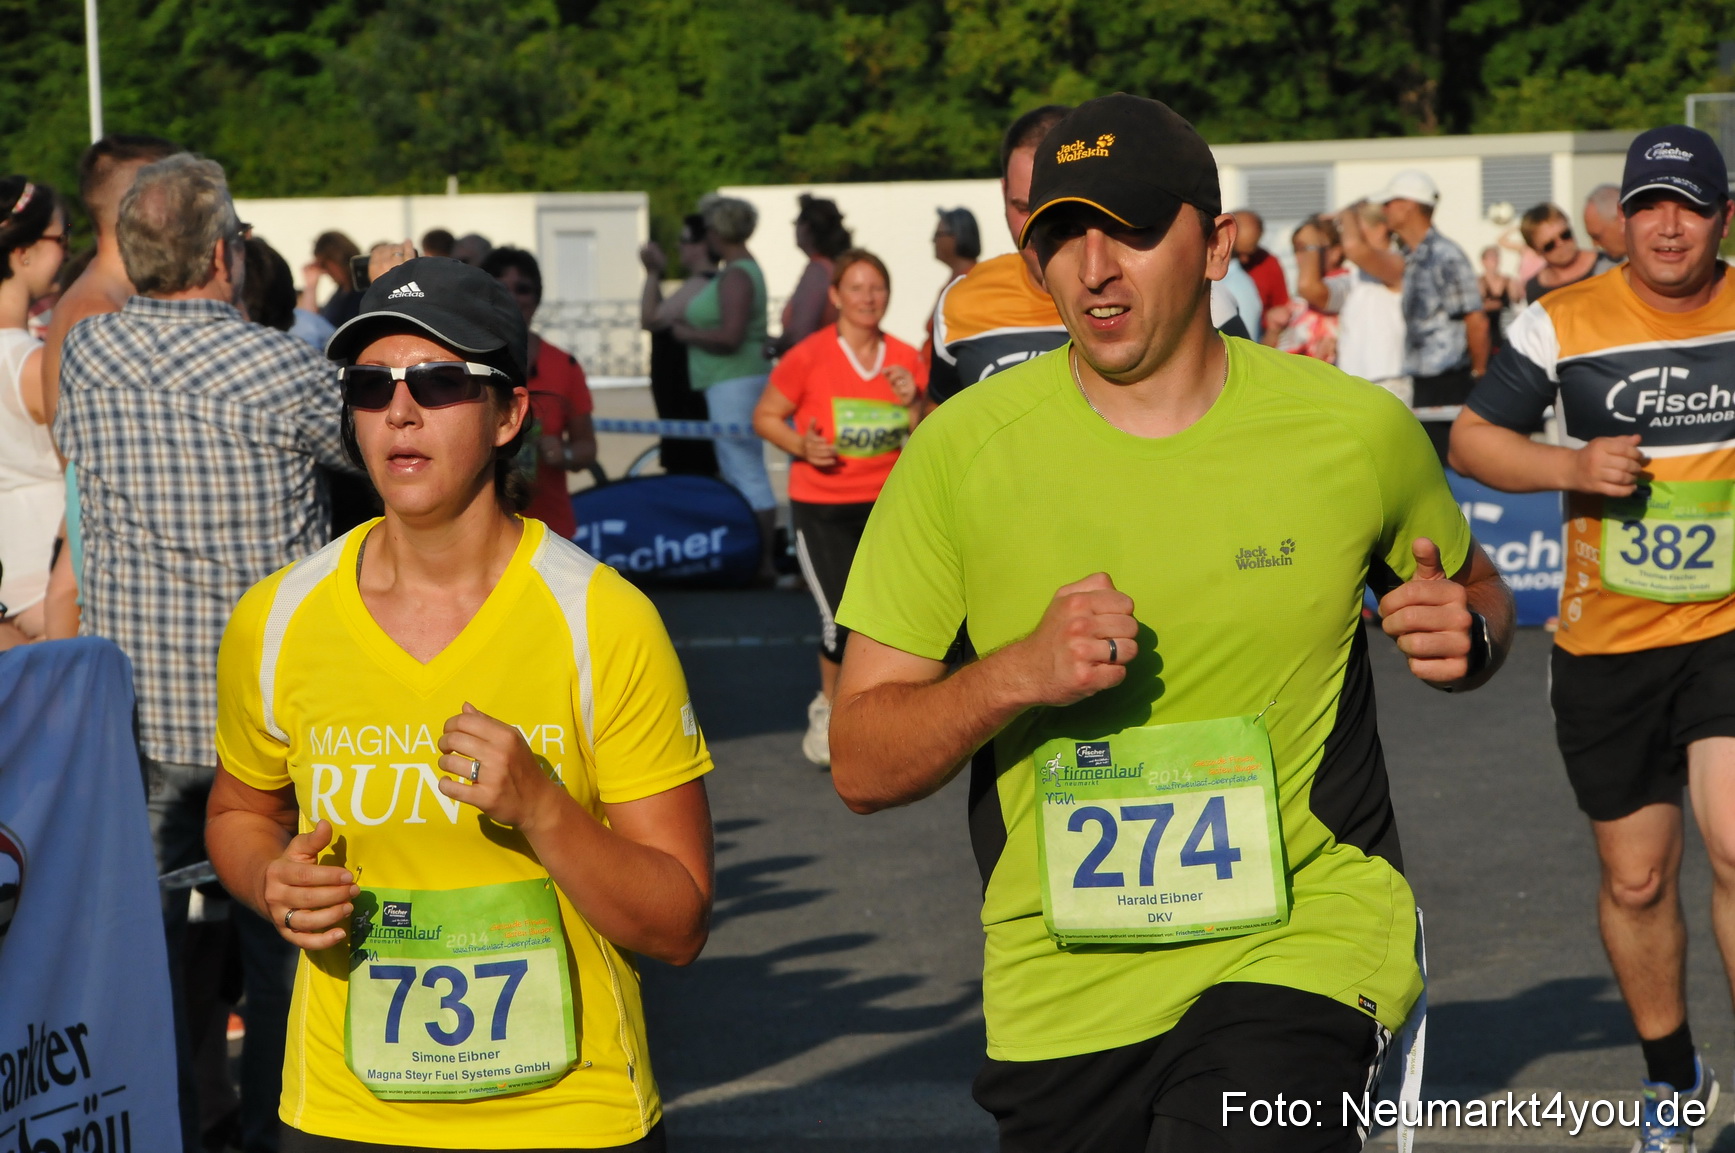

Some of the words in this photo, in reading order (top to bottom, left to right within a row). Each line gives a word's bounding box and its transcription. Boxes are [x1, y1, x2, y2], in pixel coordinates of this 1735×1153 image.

[1056, 146, 1109, 164] Wolfskin
[1057, 139, 1085, 155] Jack
[388, 290, 425, 299] adidas
[1636, 384, 1735, 415] Fisch
[1235, 546, 1267, 559] Jack
[1620, 519, 1716, 571] 382
[1236, 554, 1293, 571] Wolfskin
[309, 724, 437, 756] MAGNA
[1081, 748, 1106, 756] Fischer
[1064, 762, 1144, 780] firmenlauf
[1148, 767, 1193, 786] 2014
[309, 763, 465, 826] RUN
[1067, 795, 1242, 889] 274
[1117, 893, 1157, 906] Harald
[1160, 891, 1203, 904] Eibner
[1147, 911, 1173, 923] DKV
[369, 923, 443, 940] firmenlauf
[1175, 928, 1206, 936] Frischmann
[446, 932, 490, 949] 2014
[369, 959, 529, 1047] 737
[411, 1051, 456, 1063] Simone
[458, 1051, 501, 1064] Eibner
[0, 1020, 91, 1115] arkter
[367, 1069, 402, 1082] Magna
[405, 1070, 432, 1082] Steyr
[435, 1070, 458, 1081] Fuel
[461, 1067, 511, 1082] Systems
[514, 1061, 551, 1075] GmbH
[469, 1085, 499, 1093] Frischmann
